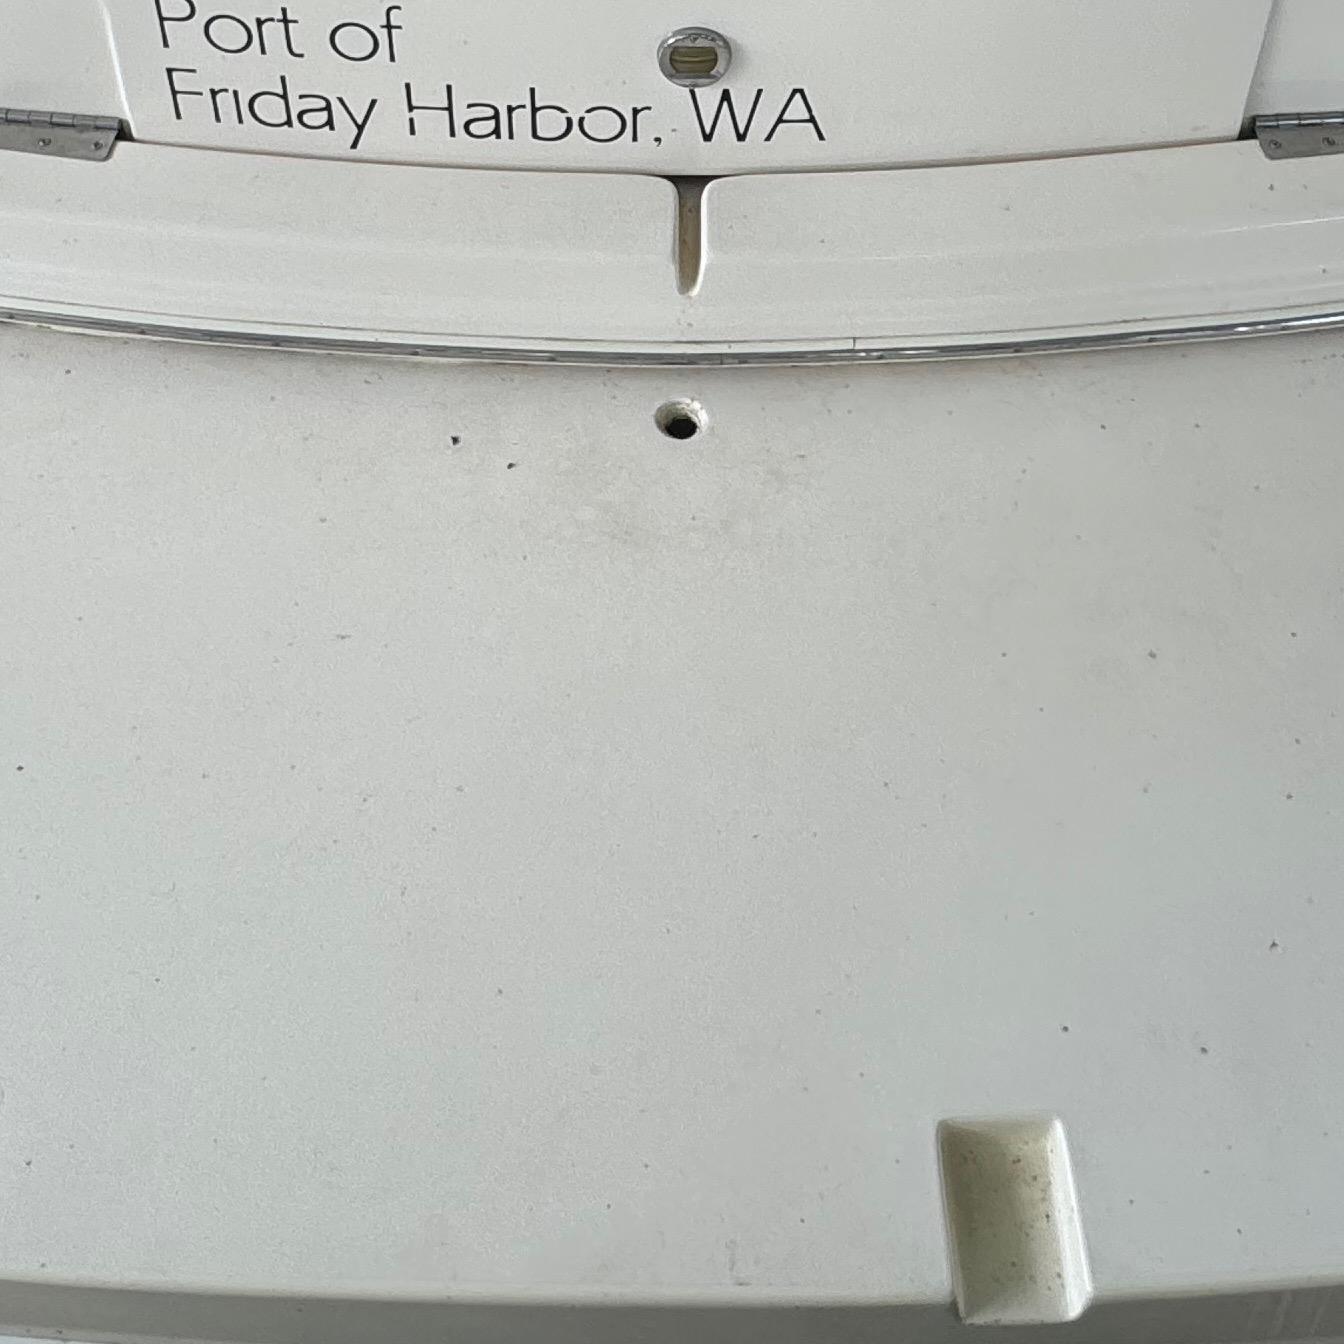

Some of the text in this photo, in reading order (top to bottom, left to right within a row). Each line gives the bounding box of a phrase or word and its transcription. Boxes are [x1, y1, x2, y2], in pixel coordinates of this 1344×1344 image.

[329, 5, 403, 63] of
[165, 67, 827, 148] Friday Harbor, WA
